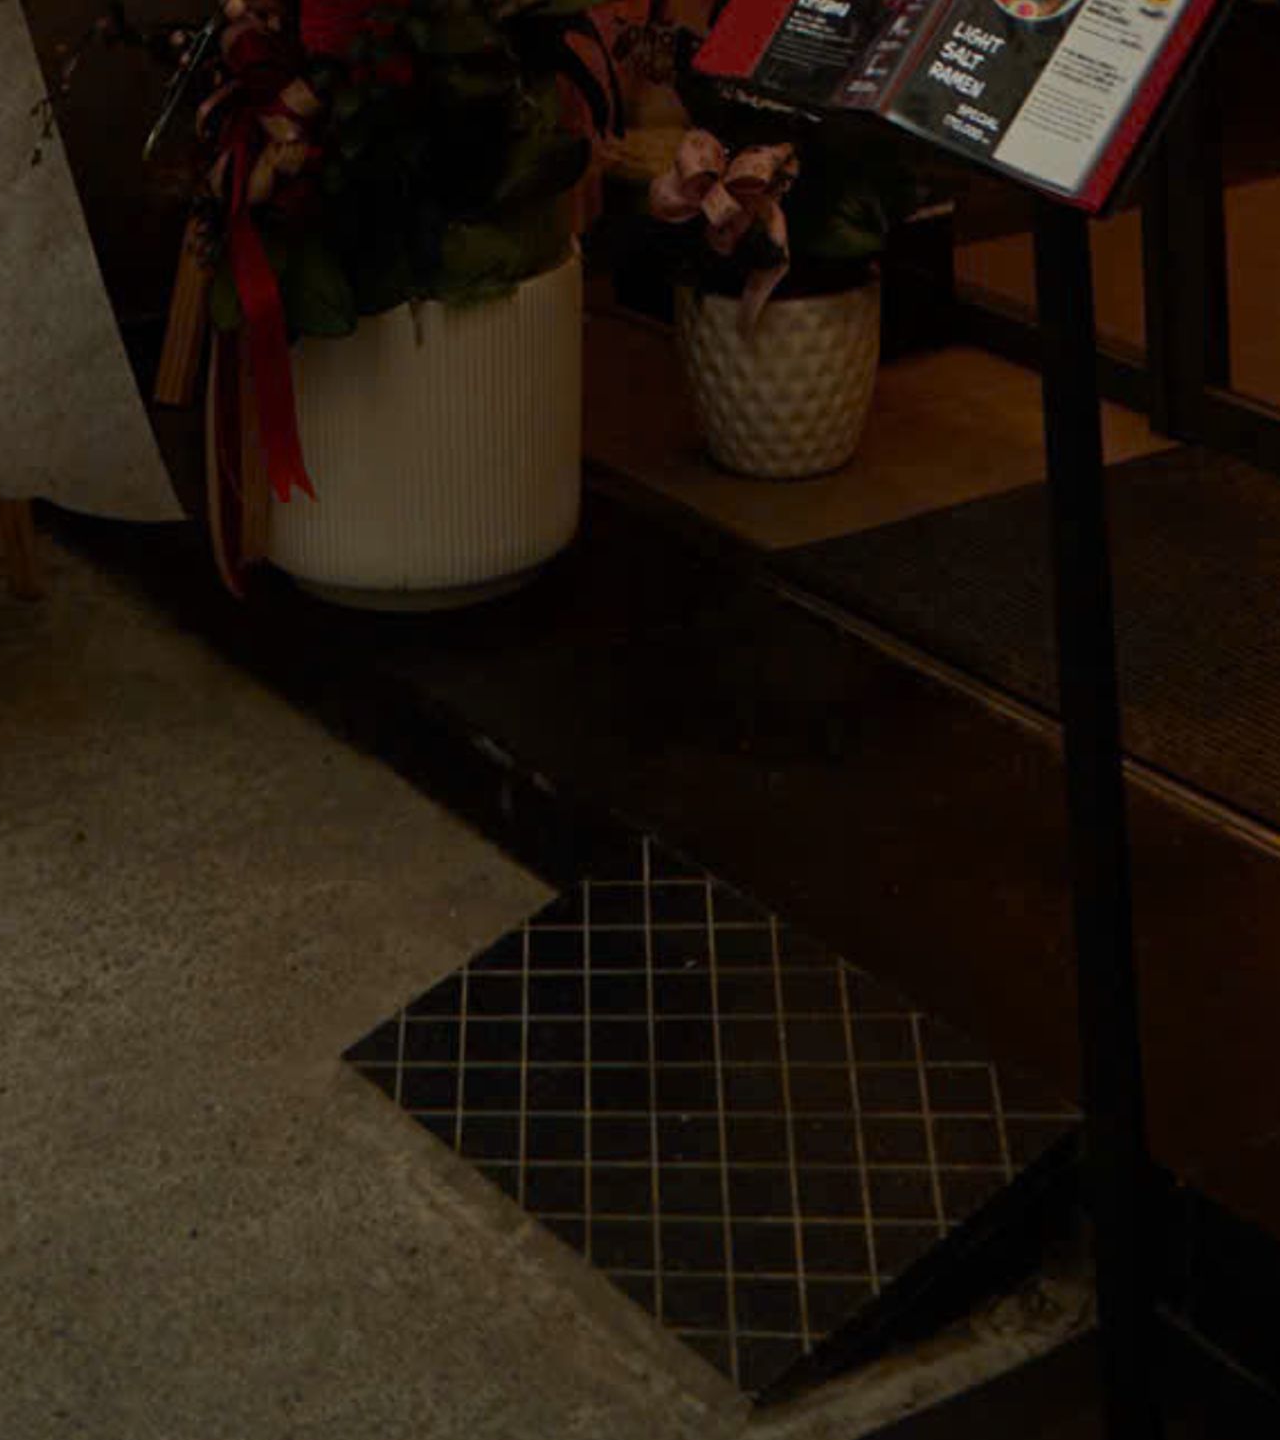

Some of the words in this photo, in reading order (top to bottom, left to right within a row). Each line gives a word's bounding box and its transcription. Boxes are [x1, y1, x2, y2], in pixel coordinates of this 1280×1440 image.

[951, 19, 1007, 55] LIGHT
[938, 40, 986, 72] SALT
[927, 59, 987, 100] RAMEN
